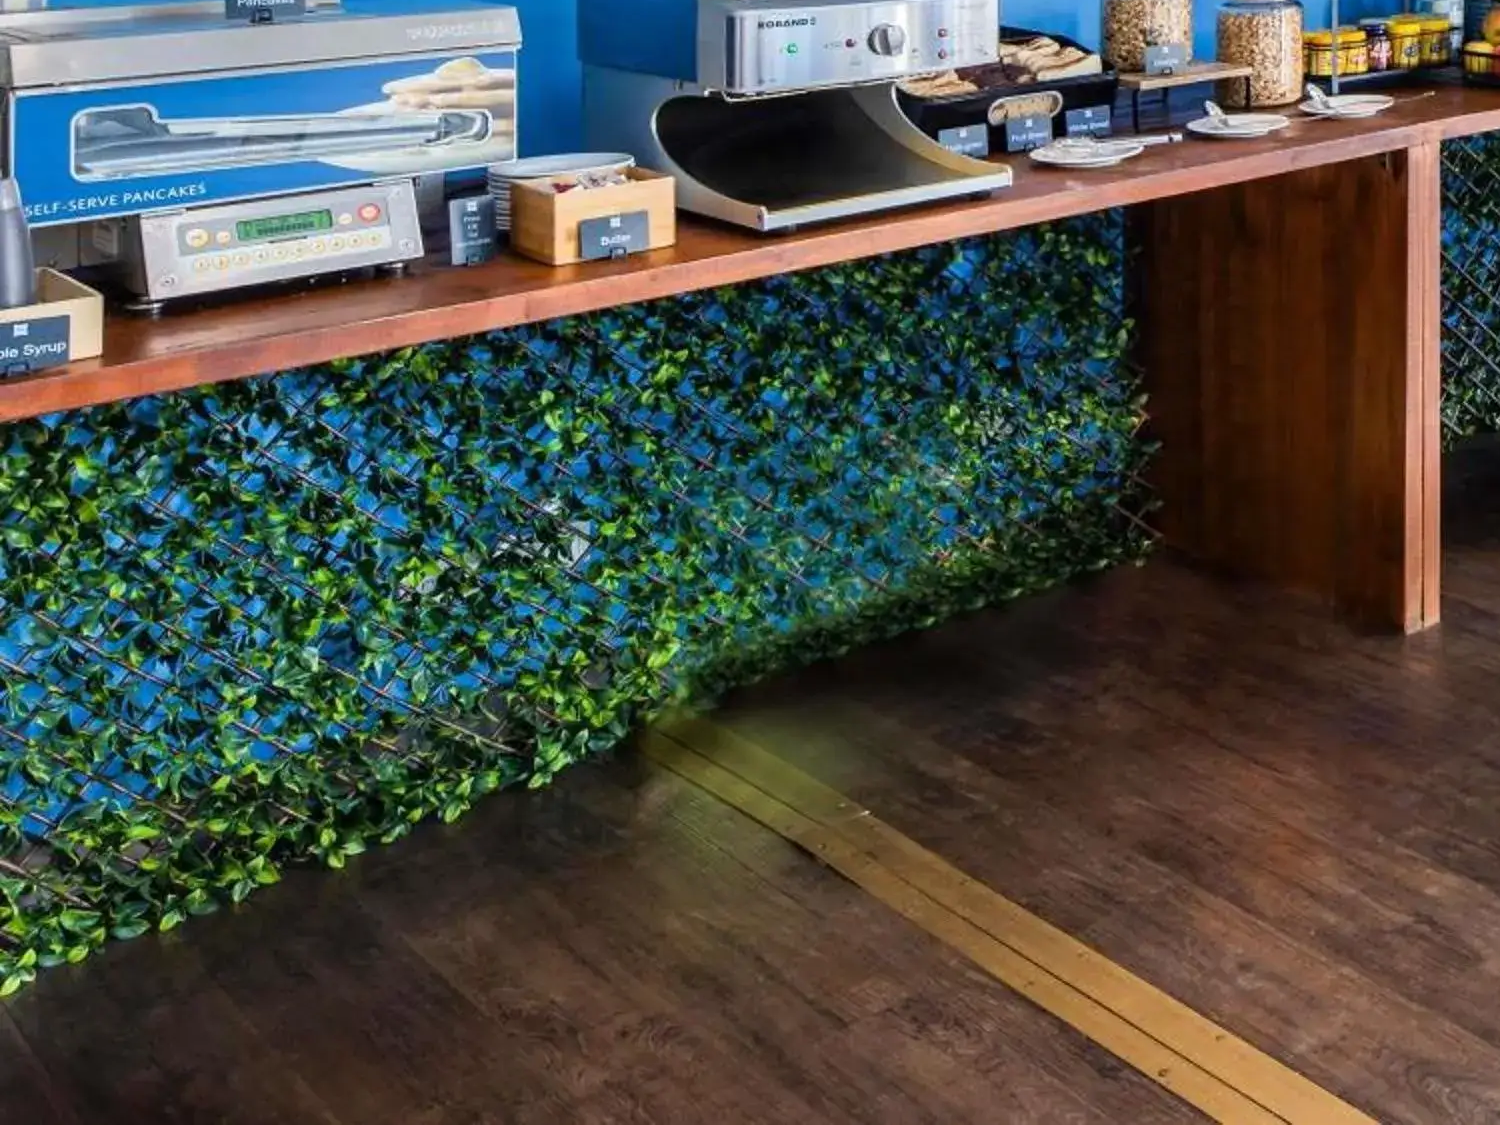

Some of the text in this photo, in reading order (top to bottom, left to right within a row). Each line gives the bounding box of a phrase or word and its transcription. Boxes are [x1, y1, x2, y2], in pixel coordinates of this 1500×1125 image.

[24, 180, 207, 218] SELF-SERVE PANCAKES
[23, 341, 67, 357] Syrup
